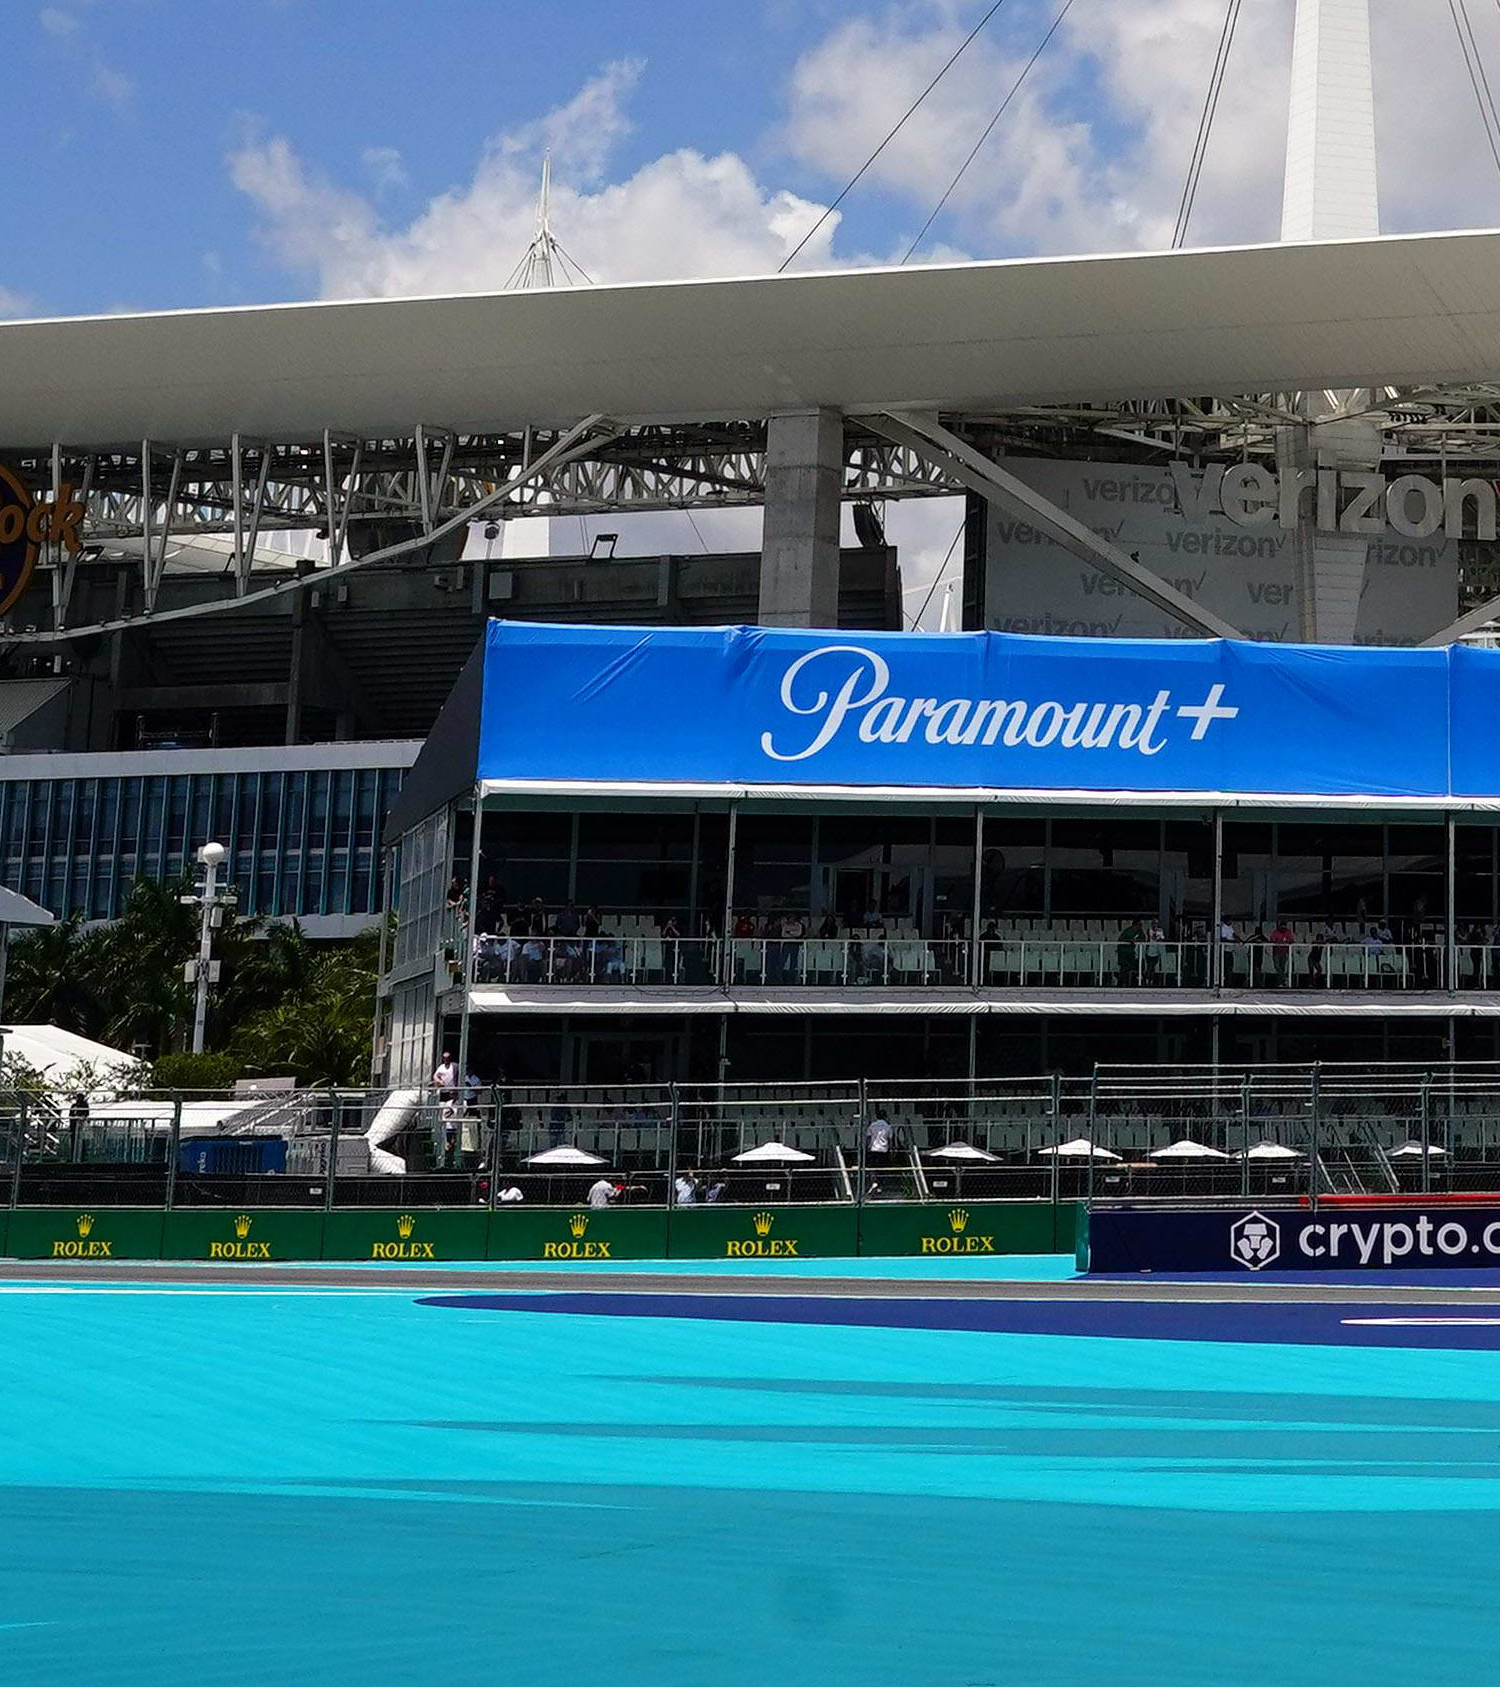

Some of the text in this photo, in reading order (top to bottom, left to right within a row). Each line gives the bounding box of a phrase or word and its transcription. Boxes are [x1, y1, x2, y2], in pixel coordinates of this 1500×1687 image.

[1081, 474, 1176, 505] verizo
[1169, 458, 1497, 541] verizon
[1164, 527, 1277, 558] verizon
[1367, 538, 1437, 569] rizon
[759, 644, 1240, 763] Paramount+
[52, 1241, 111, 1257] ROLEX
[210, 1242, 271, 1258] ROLEX
[371, 1242, 435, 1259] ROLEX
[544, 1242, 612, 1258] ROLEX
[726, 1240, 798, 1257] ROLEX
[921, 1236, 994, 1253] ROLEX
